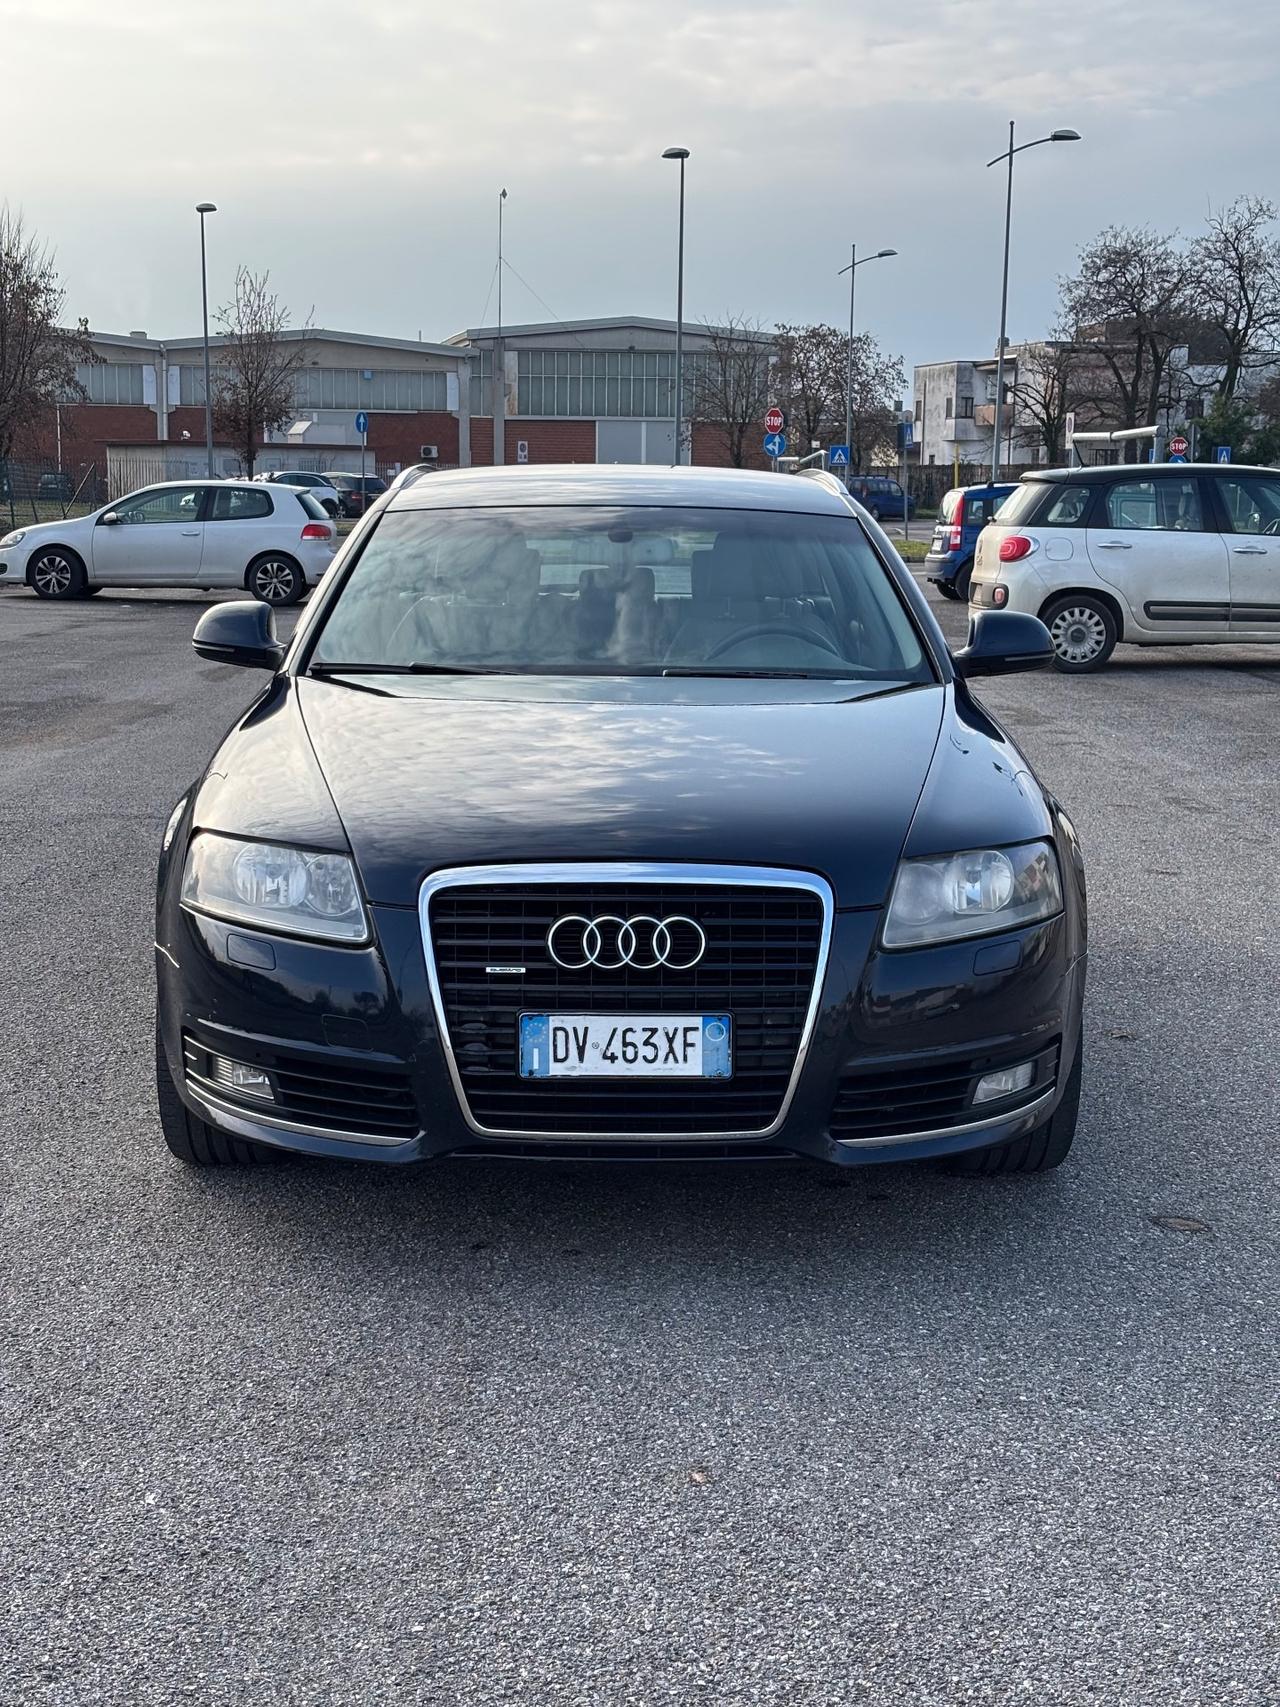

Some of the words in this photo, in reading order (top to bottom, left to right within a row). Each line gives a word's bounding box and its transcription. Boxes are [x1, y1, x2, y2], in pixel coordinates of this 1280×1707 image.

[766, 416, 783, 426] STOP
[1171, 442, 1187, 451] STOP
[552, 1026, 589, 1064] DV
[601, 1026, 700, 1065] 463XF
